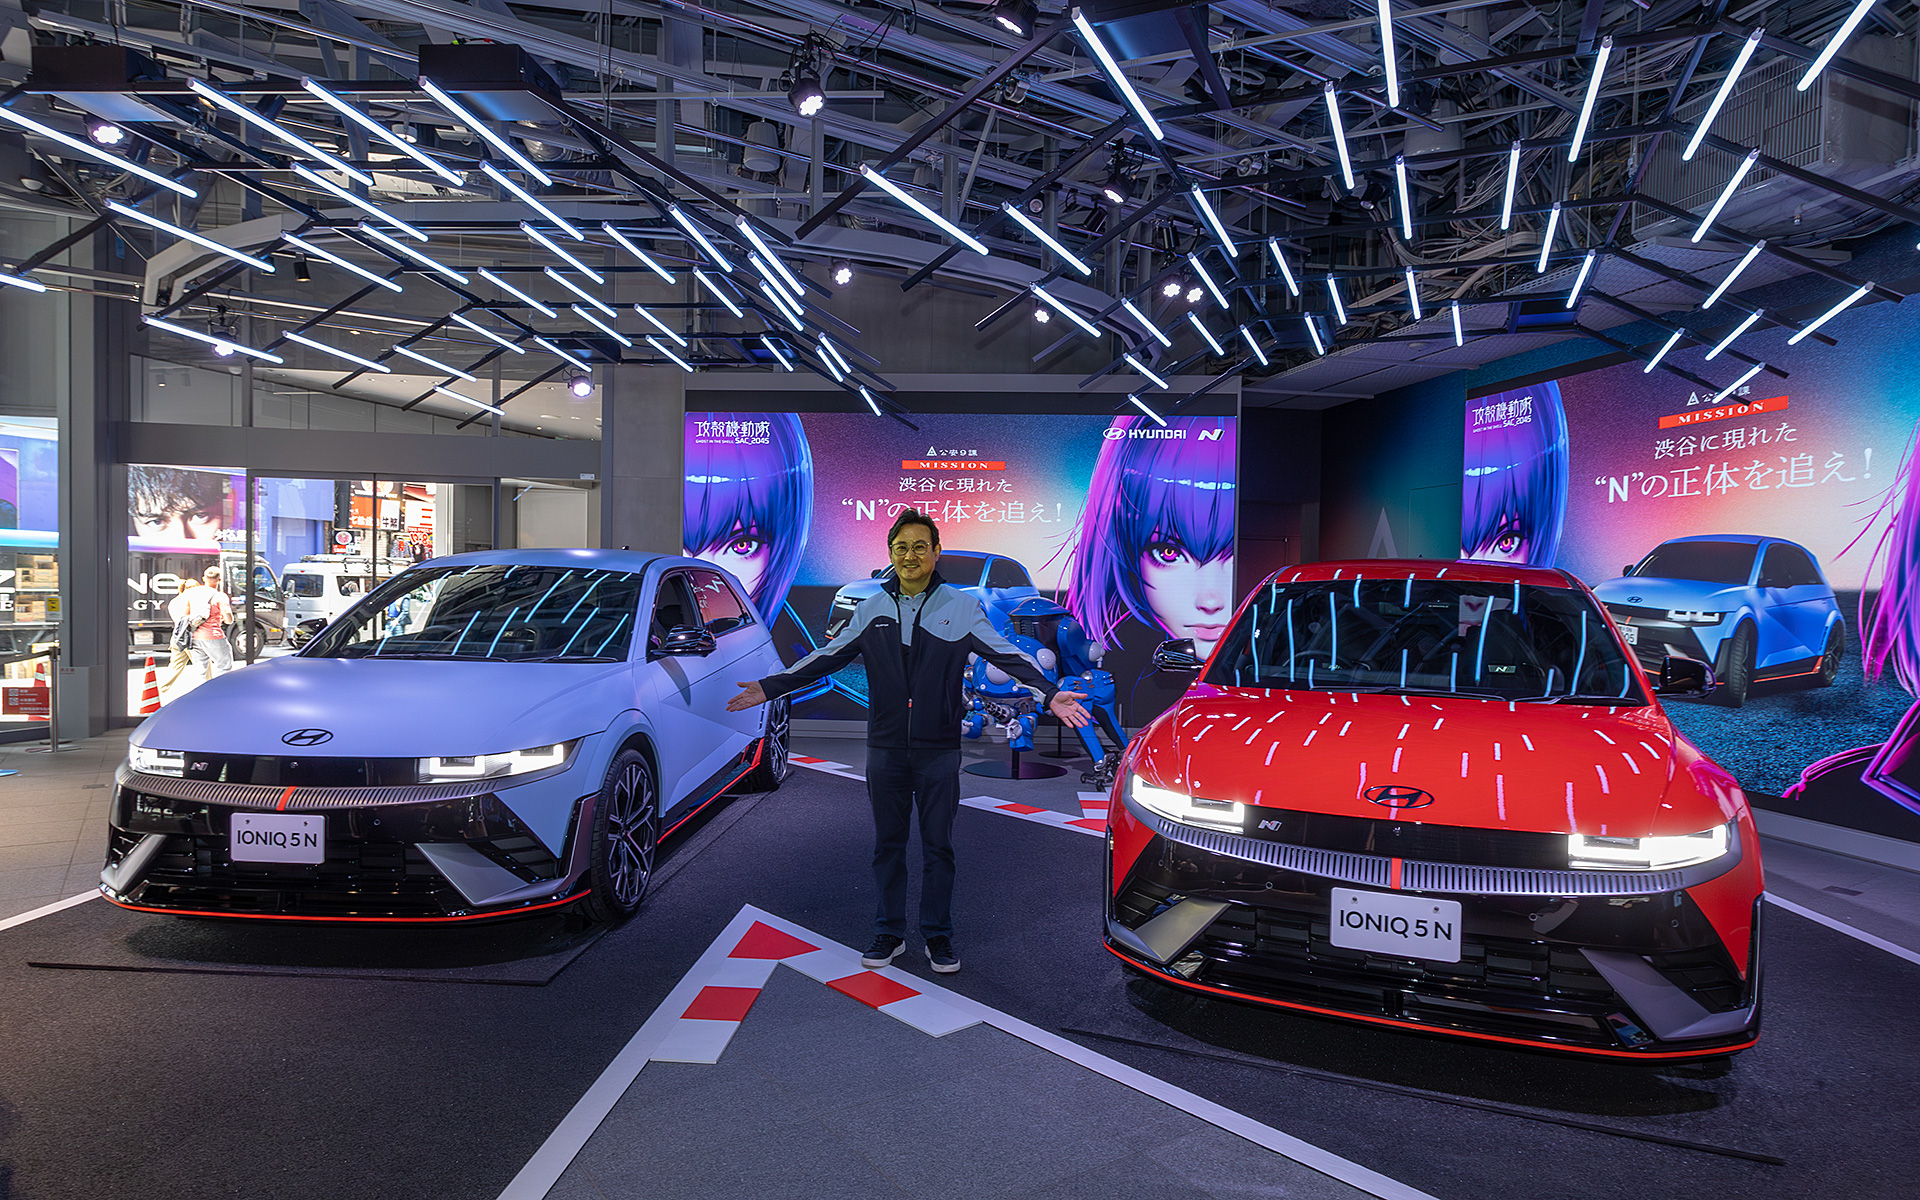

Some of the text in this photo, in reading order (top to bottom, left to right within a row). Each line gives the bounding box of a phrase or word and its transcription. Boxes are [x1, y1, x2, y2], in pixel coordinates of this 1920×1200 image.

[1678, 402, 1765, 424] MISSION
[693, 420, 771, 438] 攻殻機動隊
[1128, 428, 1187, 440] HYUNDAI
[734, 437, 770, 446] SAC_2045
[1654, 422, 1798, 460] 渋谷に現れた
[918, 462, 989, 470] MISSION
[898, 476, 1013, 493] 渋谷に現れた
[237, 830, 317, 849] IONIQ 5 N
[1340, 909, 1452, 941] IONIQ 5 N
